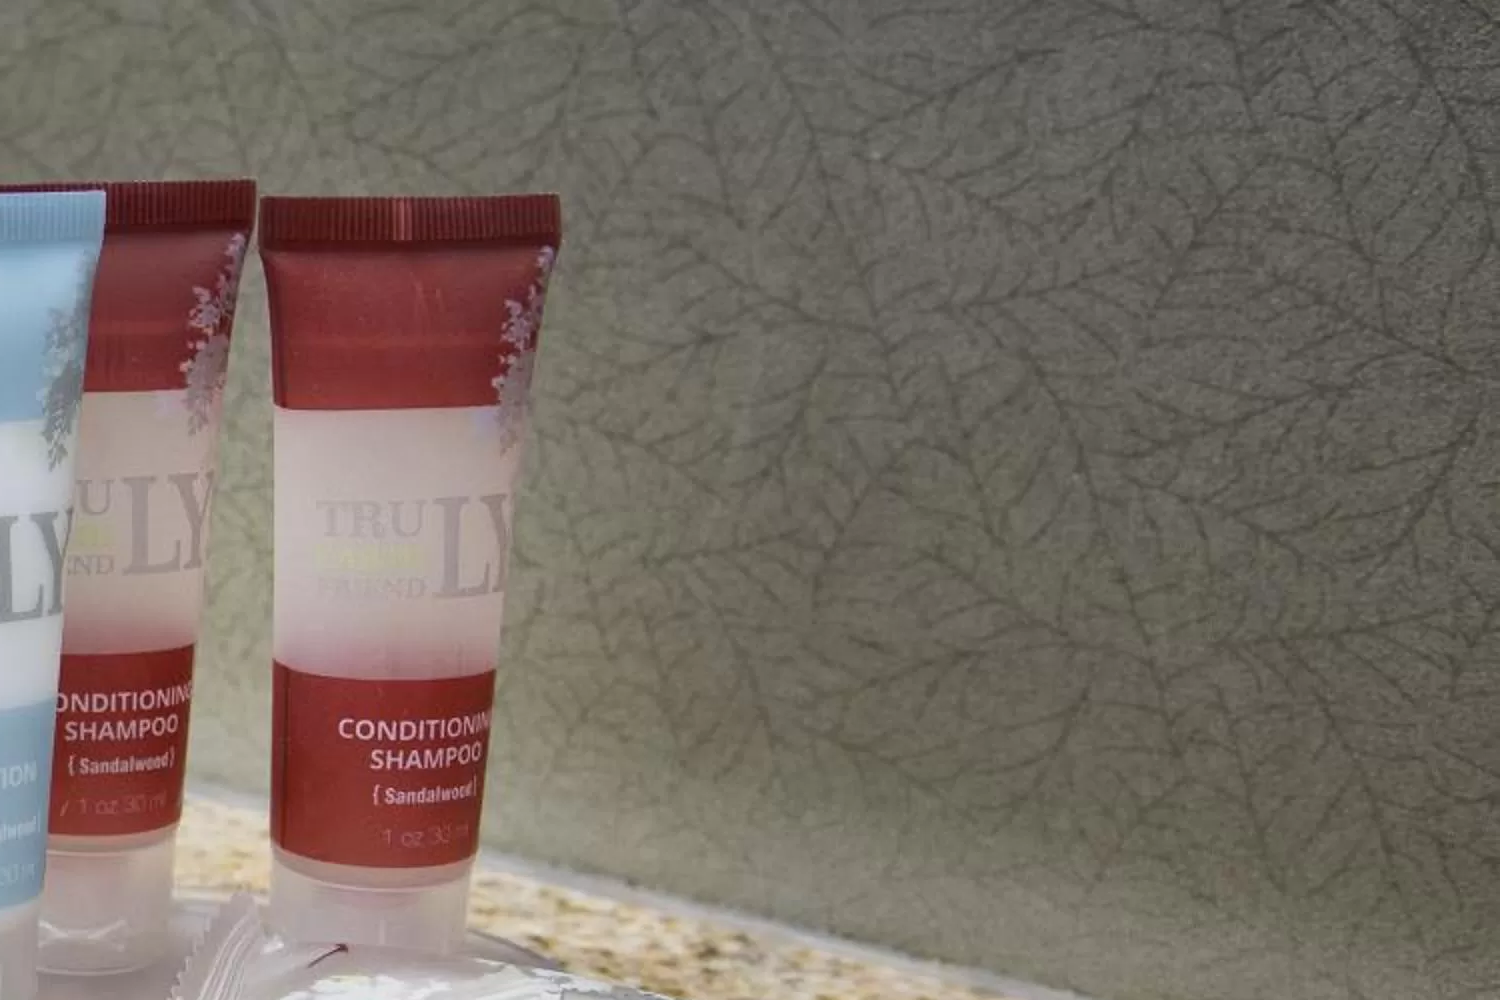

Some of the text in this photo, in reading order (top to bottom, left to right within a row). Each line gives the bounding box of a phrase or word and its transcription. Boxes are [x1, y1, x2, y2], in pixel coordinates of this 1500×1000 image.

[56, 682, 192, 713] ONDITIONIN
[64, 714, 179, 741] SHAMPOO
[338, 711, 490, 741] CONDITIONIN
[369, 741, 482, 770] SHAMPOO
